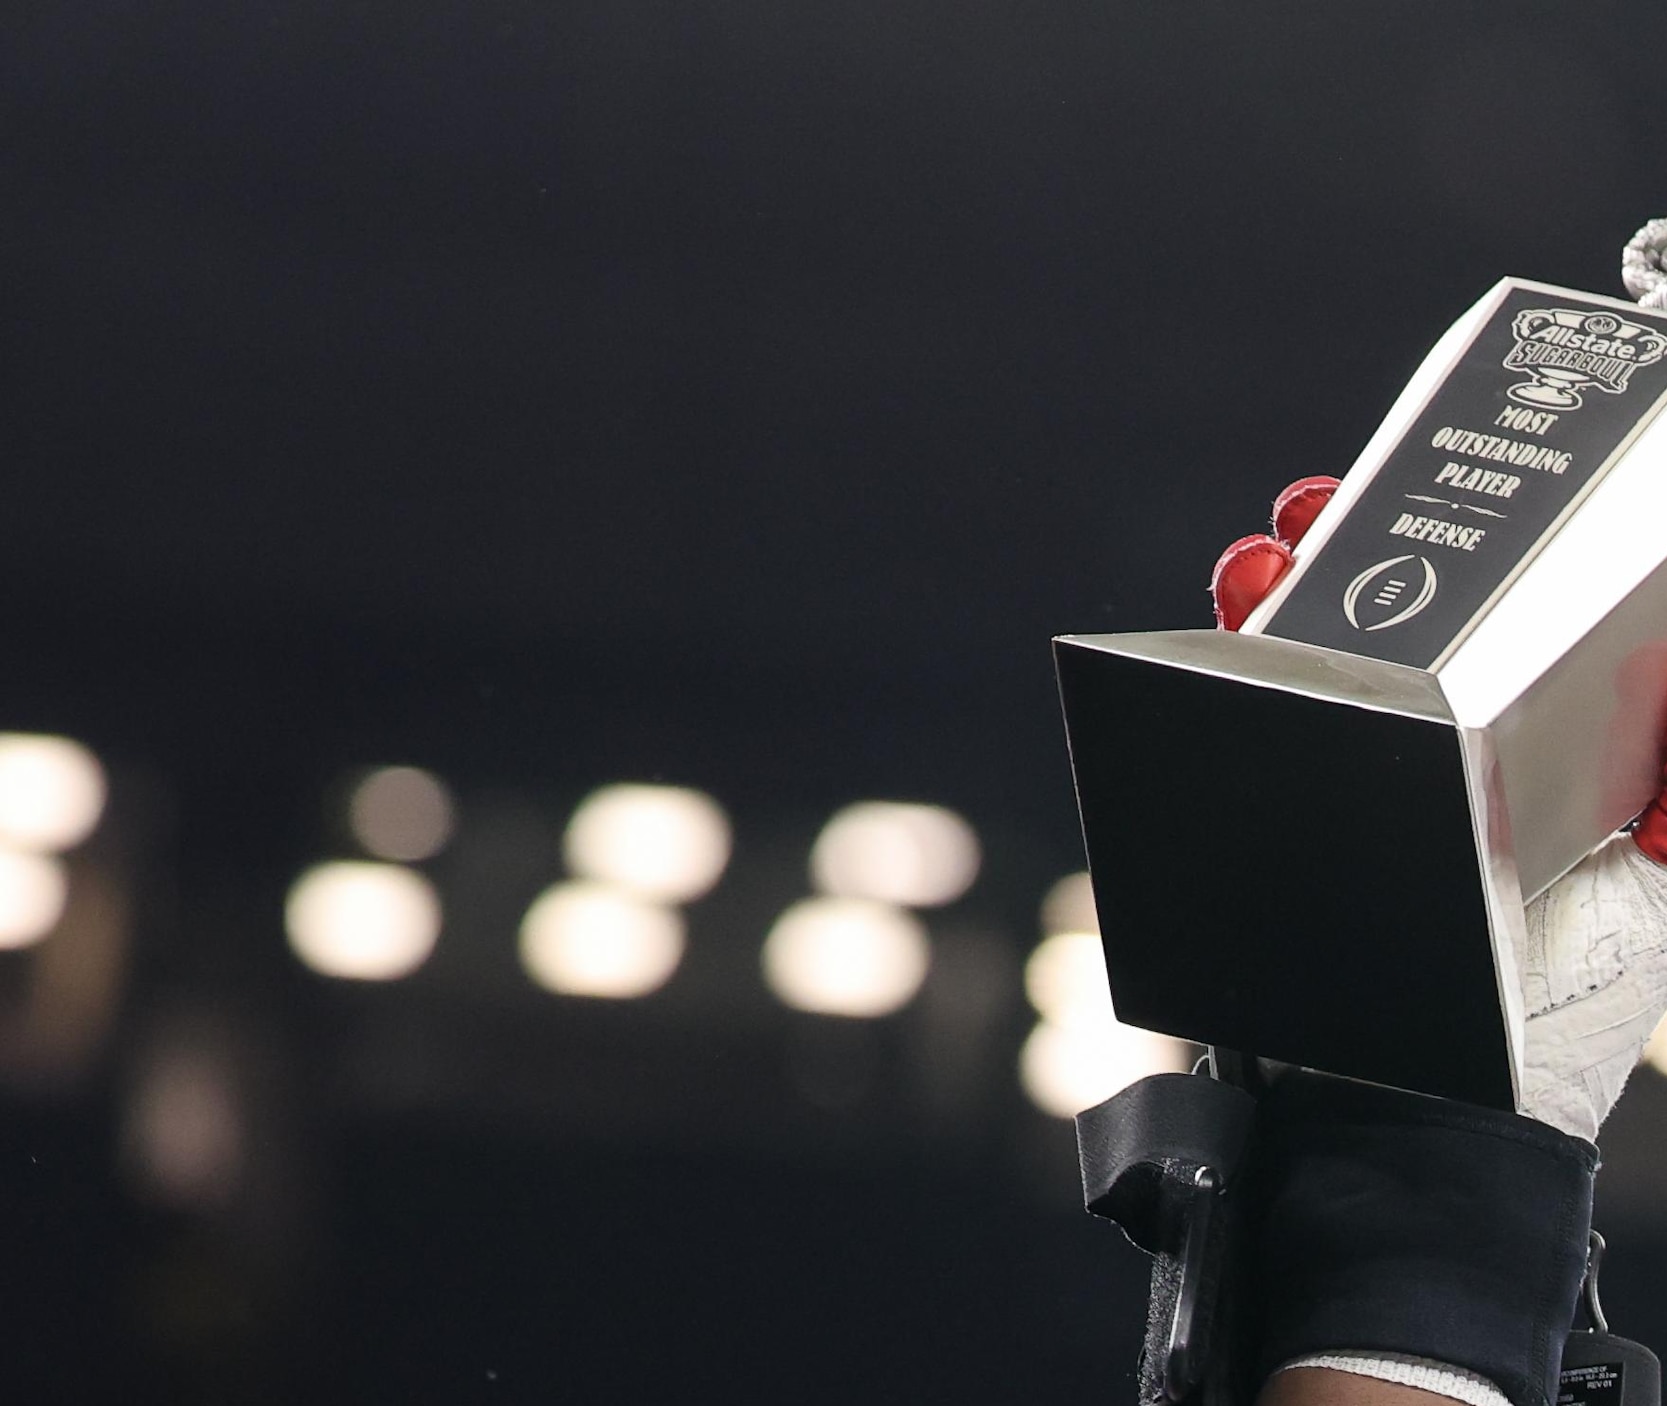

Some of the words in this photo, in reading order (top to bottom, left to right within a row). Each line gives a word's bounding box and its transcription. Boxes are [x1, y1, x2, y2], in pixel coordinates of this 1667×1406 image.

[1528, 325, 1637, 361] Allstate
[1494, 404, 1559, 436] MOST
[1431, 426, 1574, 476] OUTSTANDING
[1434, 461, 1522, 499] PLAYER
[1389, 512, 1486, 552] DEFENSE
